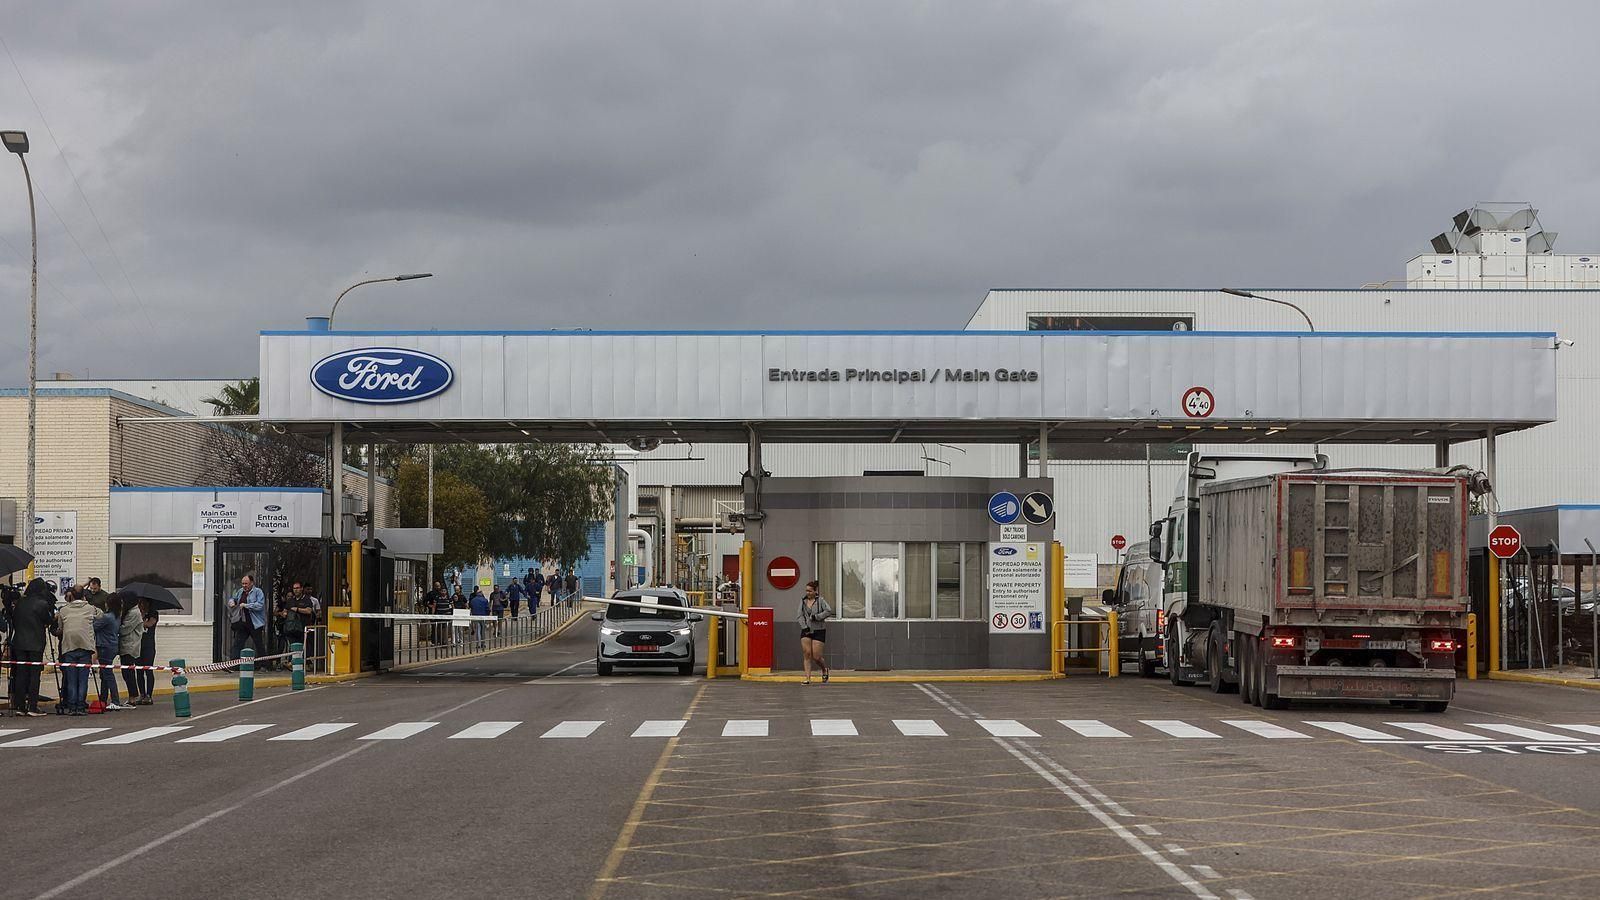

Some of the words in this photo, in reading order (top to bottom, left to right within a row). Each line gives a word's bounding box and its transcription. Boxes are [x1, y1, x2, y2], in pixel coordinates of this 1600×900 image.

[339, 356, 424, 390] Ford
[768, 368, 840, 382] Entrada
[845, 368, 926, 384] Principal
[930, 368, 940, 383] /
[945, 368, 990, 382] Main
[994, 368, 1038, 382] Gate
